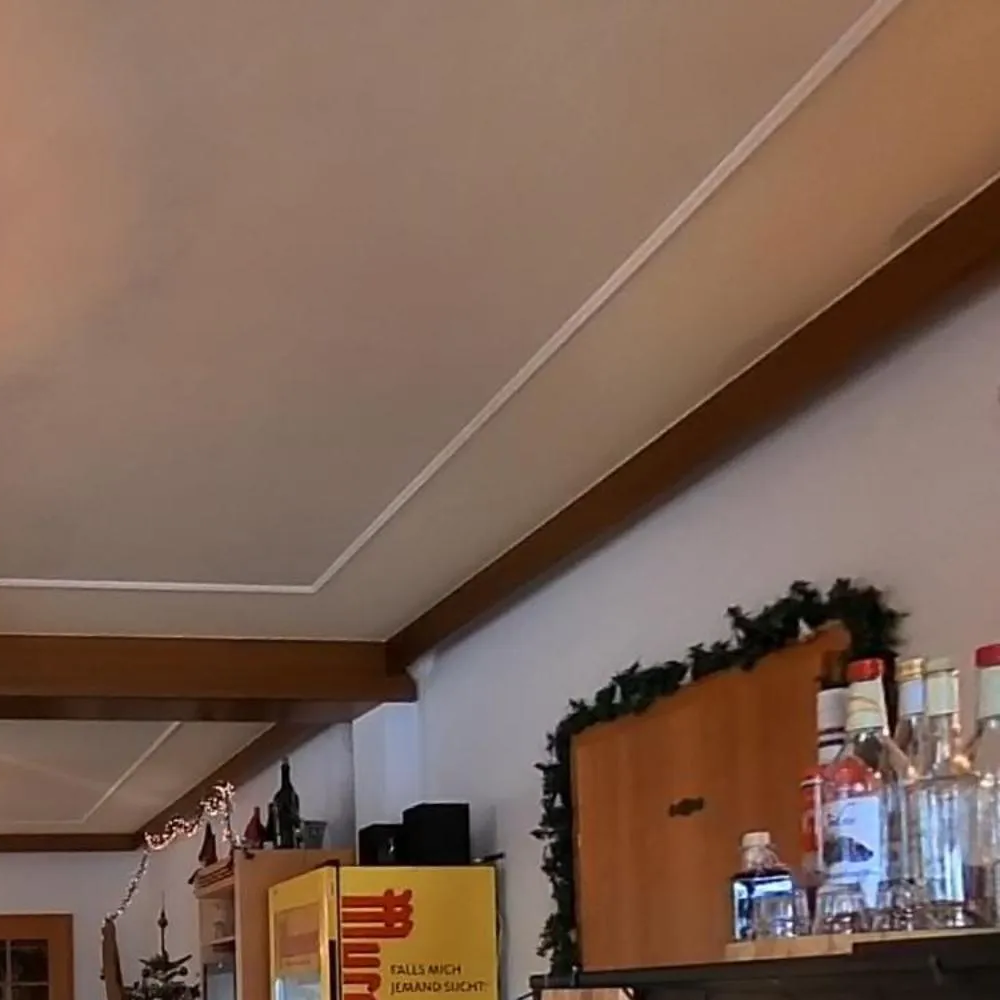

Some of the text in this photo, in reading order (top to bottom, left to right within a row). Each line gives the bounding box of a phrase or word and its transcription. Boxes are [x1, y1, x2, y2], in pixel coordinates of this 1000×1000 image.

[390, 963, 462, 975] FALLS MICH
[389, 981, 442, 996] JEMAND
